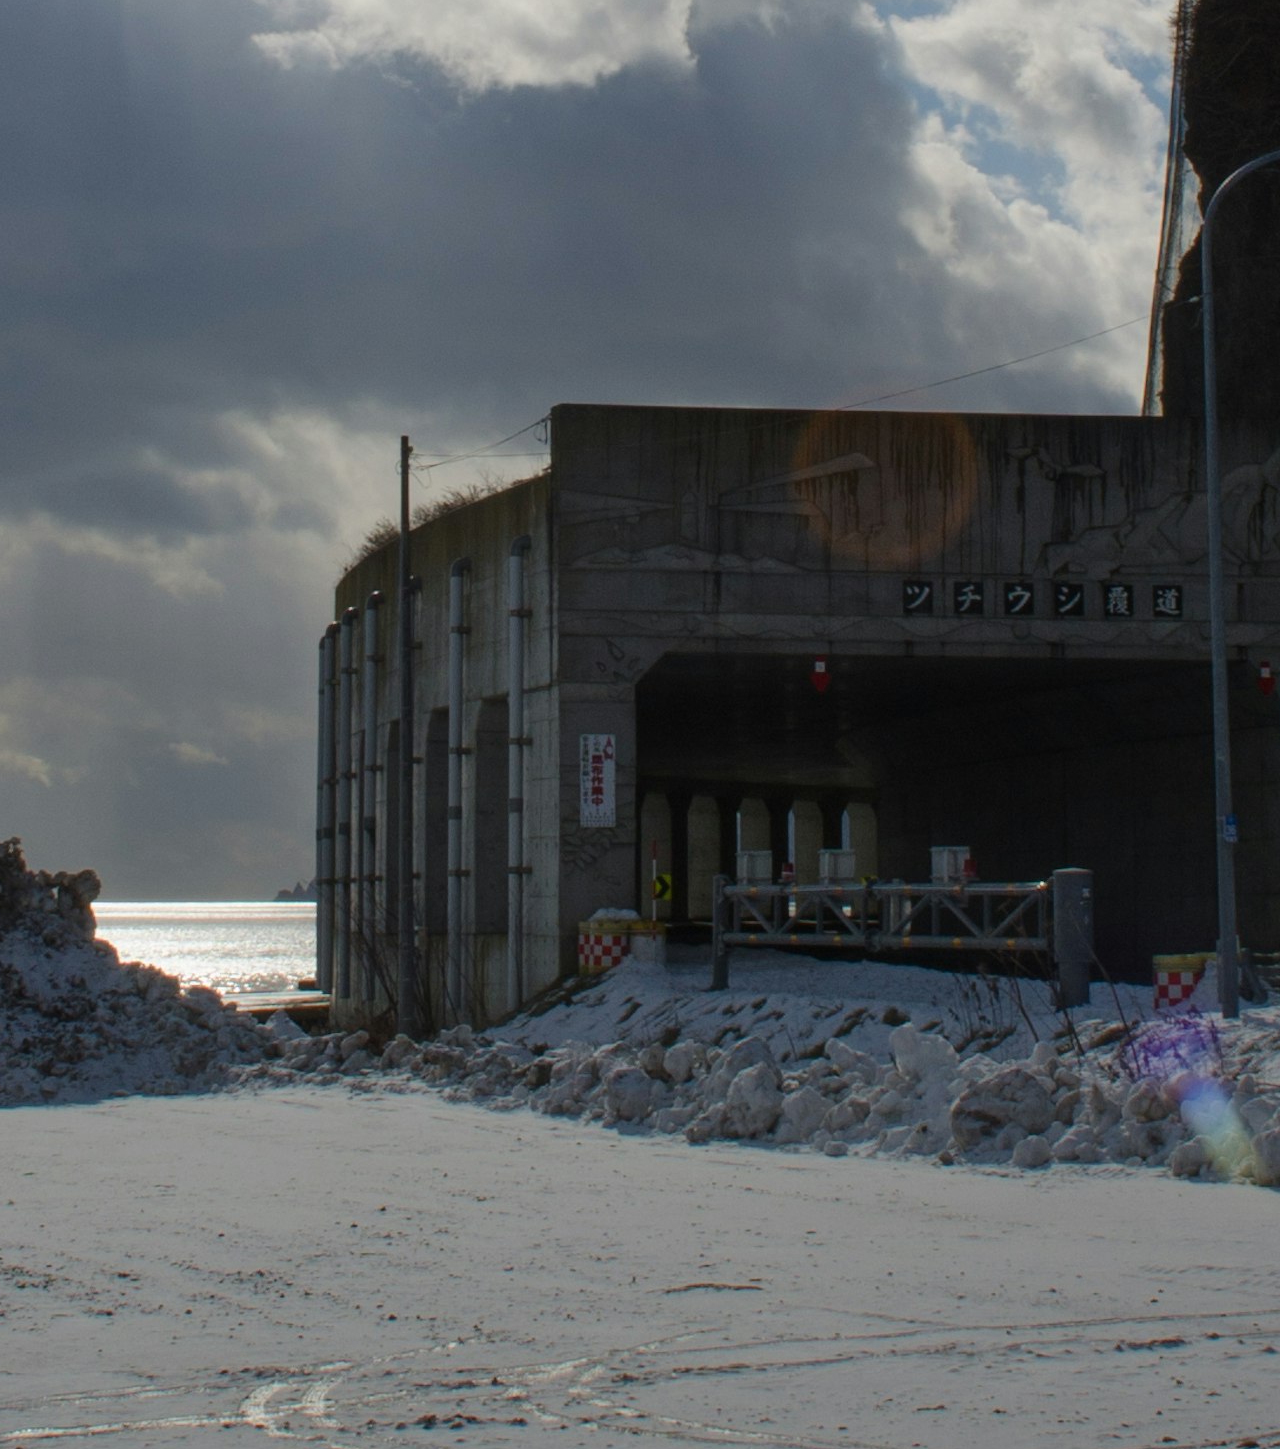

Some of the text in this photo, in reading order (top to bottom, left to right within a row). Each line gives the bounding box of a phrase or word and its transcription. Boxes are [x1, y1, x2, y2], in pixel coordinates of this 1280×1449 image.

[906, 584, 1181, 616] ツチウシ覆道
